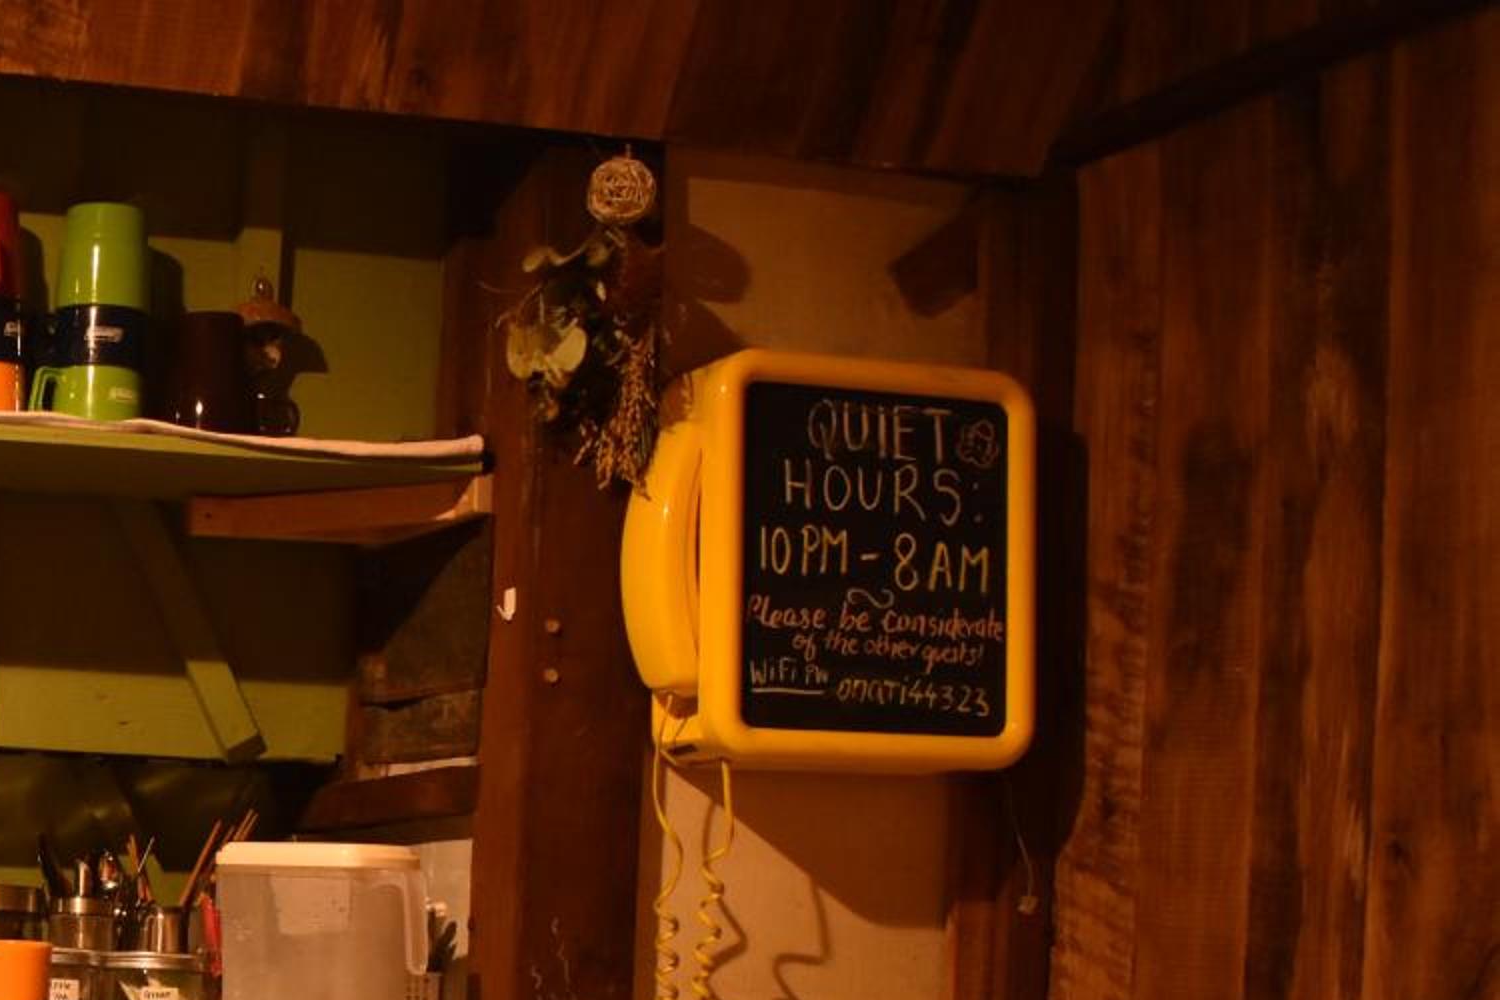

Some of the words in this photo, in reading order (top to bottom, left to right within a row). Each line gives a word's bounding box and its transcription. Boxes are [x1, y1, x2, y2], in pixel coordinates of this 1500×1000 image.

[807, 399, 952, 463] QUIET
[749, 594, 827, 630] Please
[840, 601, 871, 632] be
[792, 634, 817, 662] of
[824, 629, 859, 656] the
[863, 634, 921, 658] other
